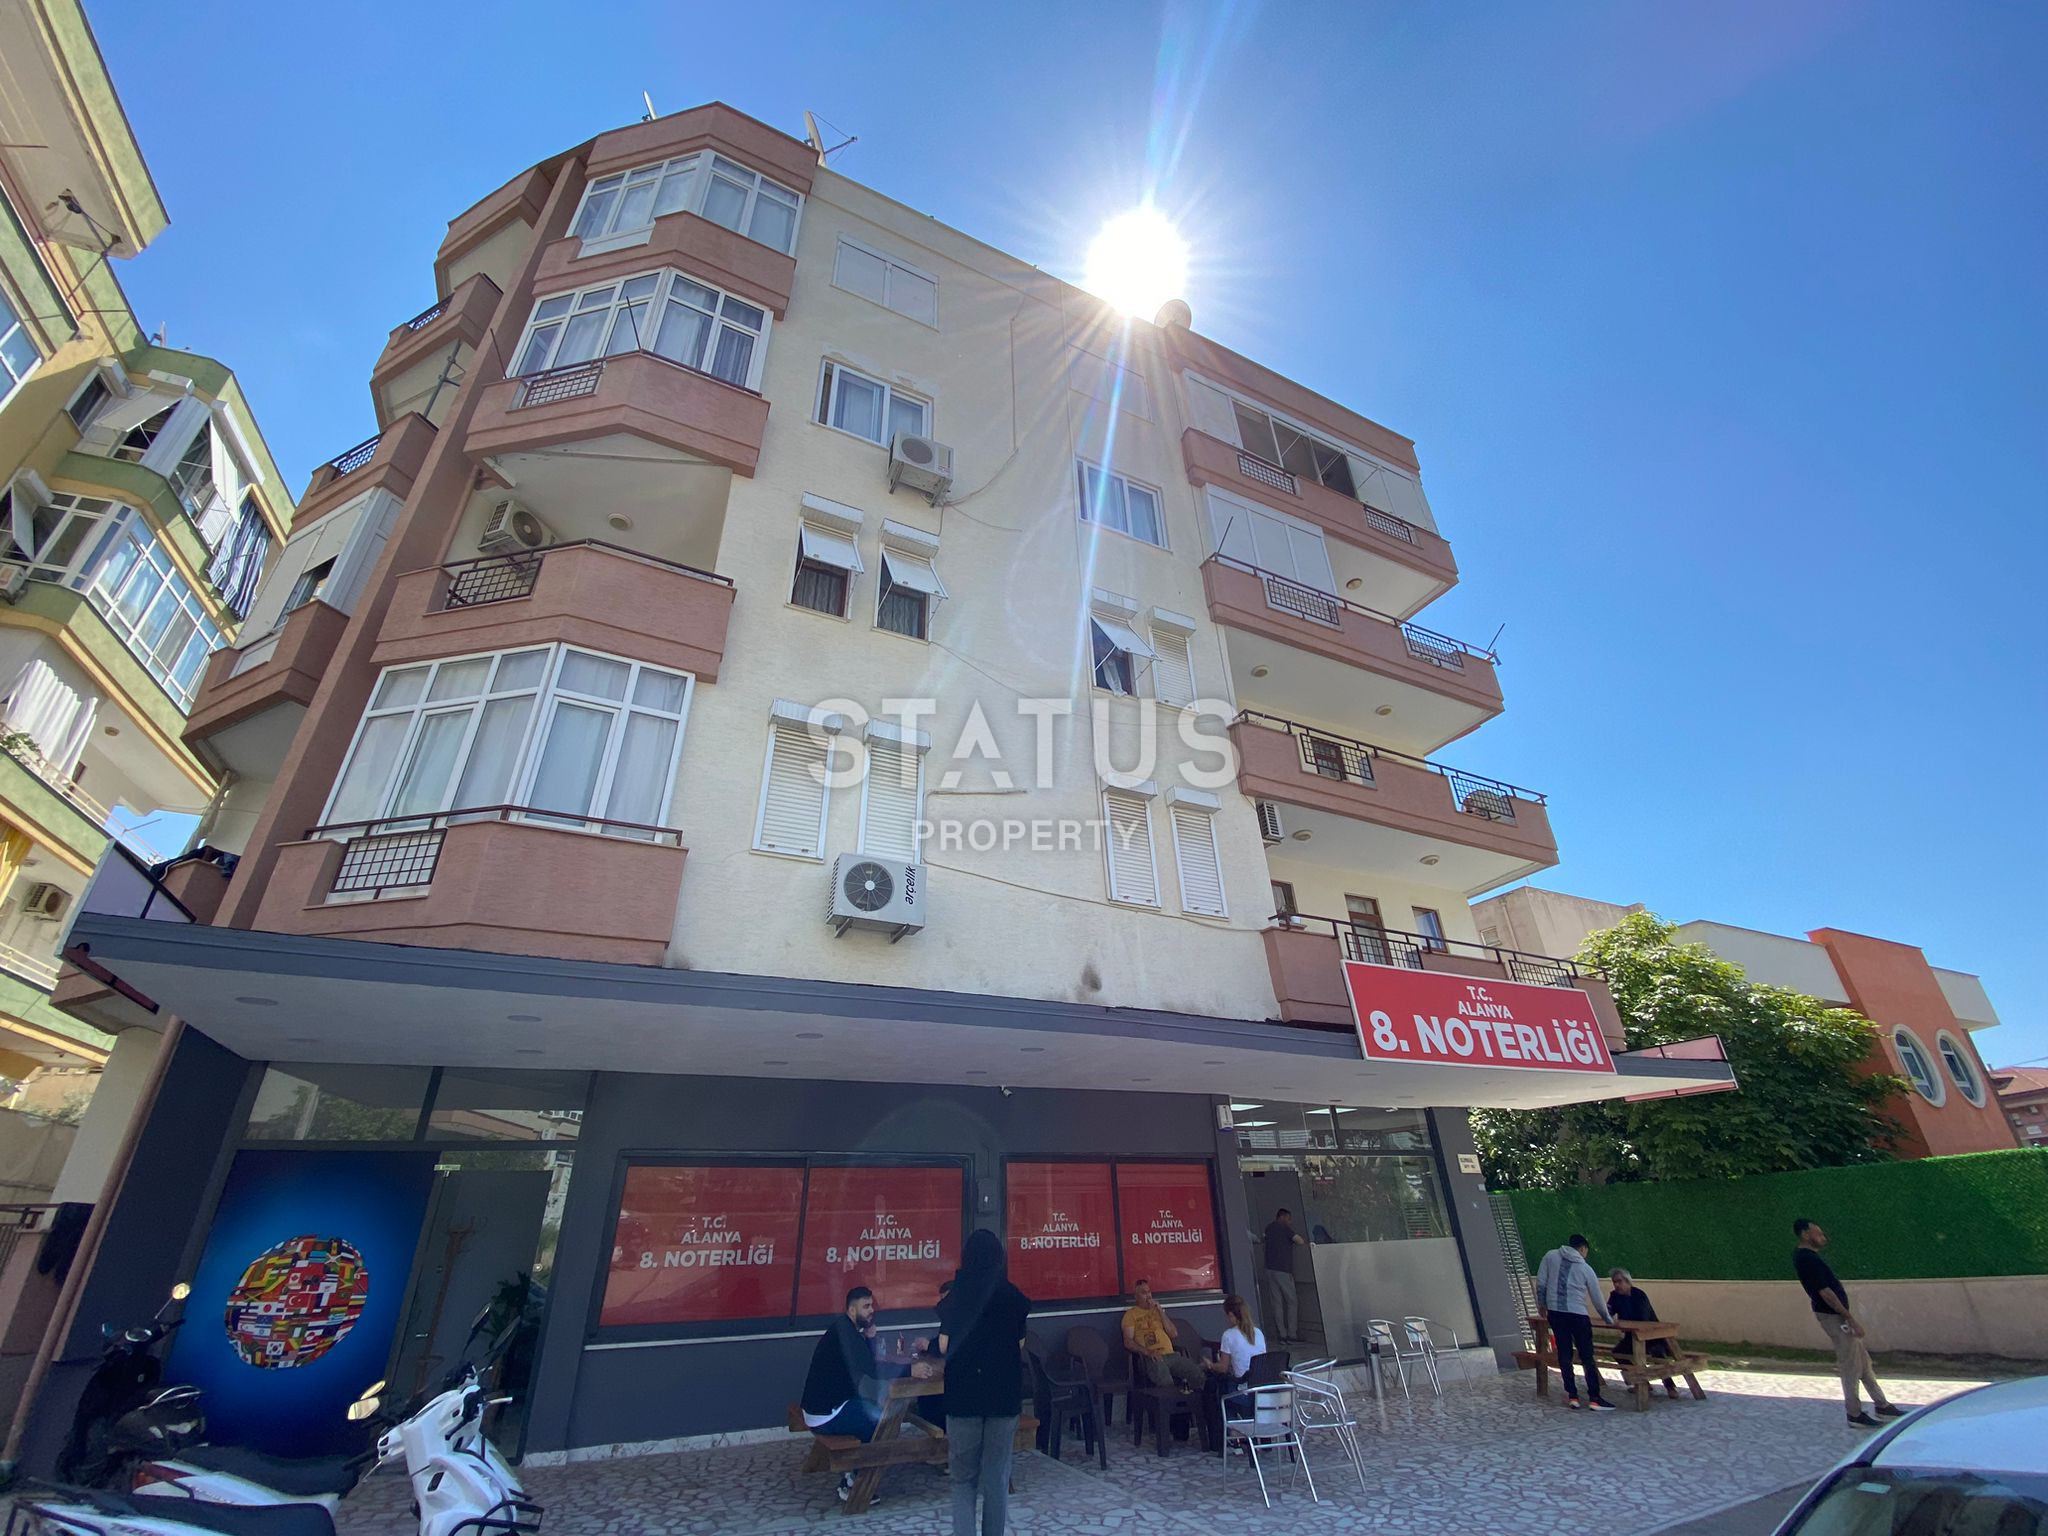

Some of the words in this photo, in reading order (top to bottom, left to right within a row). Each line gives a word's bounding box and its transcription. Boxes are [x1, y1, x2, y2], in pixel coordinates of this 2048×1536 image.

[904, 865, 917, 905] arçelik
[1466, 985, 1493, 1001] T.C.
[1458, 1000, 1514, 1020] ALANYA
[1369, 1010, 1410, 1052] 8.
[1413, 1014, 1604, 1065] NOTERLİĞİ
[875, 1214, 898, 1226] T.C.
[1053, 1213, 1069, 1222] T.C.
[1159, 1210, 1173, 1219] T.C.
[702, 1215, 727, 1229] T.C.
[1042, 1223, 1079, 1233] ALANYA
[1151, 1220, 1183, 1229] ALANYA
[680, 1231, 742, 1244] ALANYA
[860, 1227, 912, 1240] ALANYA
[1131, 1232, 1143, 1244] 8.
[1145, 1229, 1202, 1244] NOTERLİĞİ
[1020, 1237, 1032, 1250] 8.
[1034, 1232, 1100, 1250] NOTERLİĞİ
[639, 1251, 658, 1268] 8.
[664, 1244, 774, 1268] NOTERLİĞİ
[826, 1247, 841, 1263] 8.
[847, 1239, 941, 1262] NOTERLİĞİ
